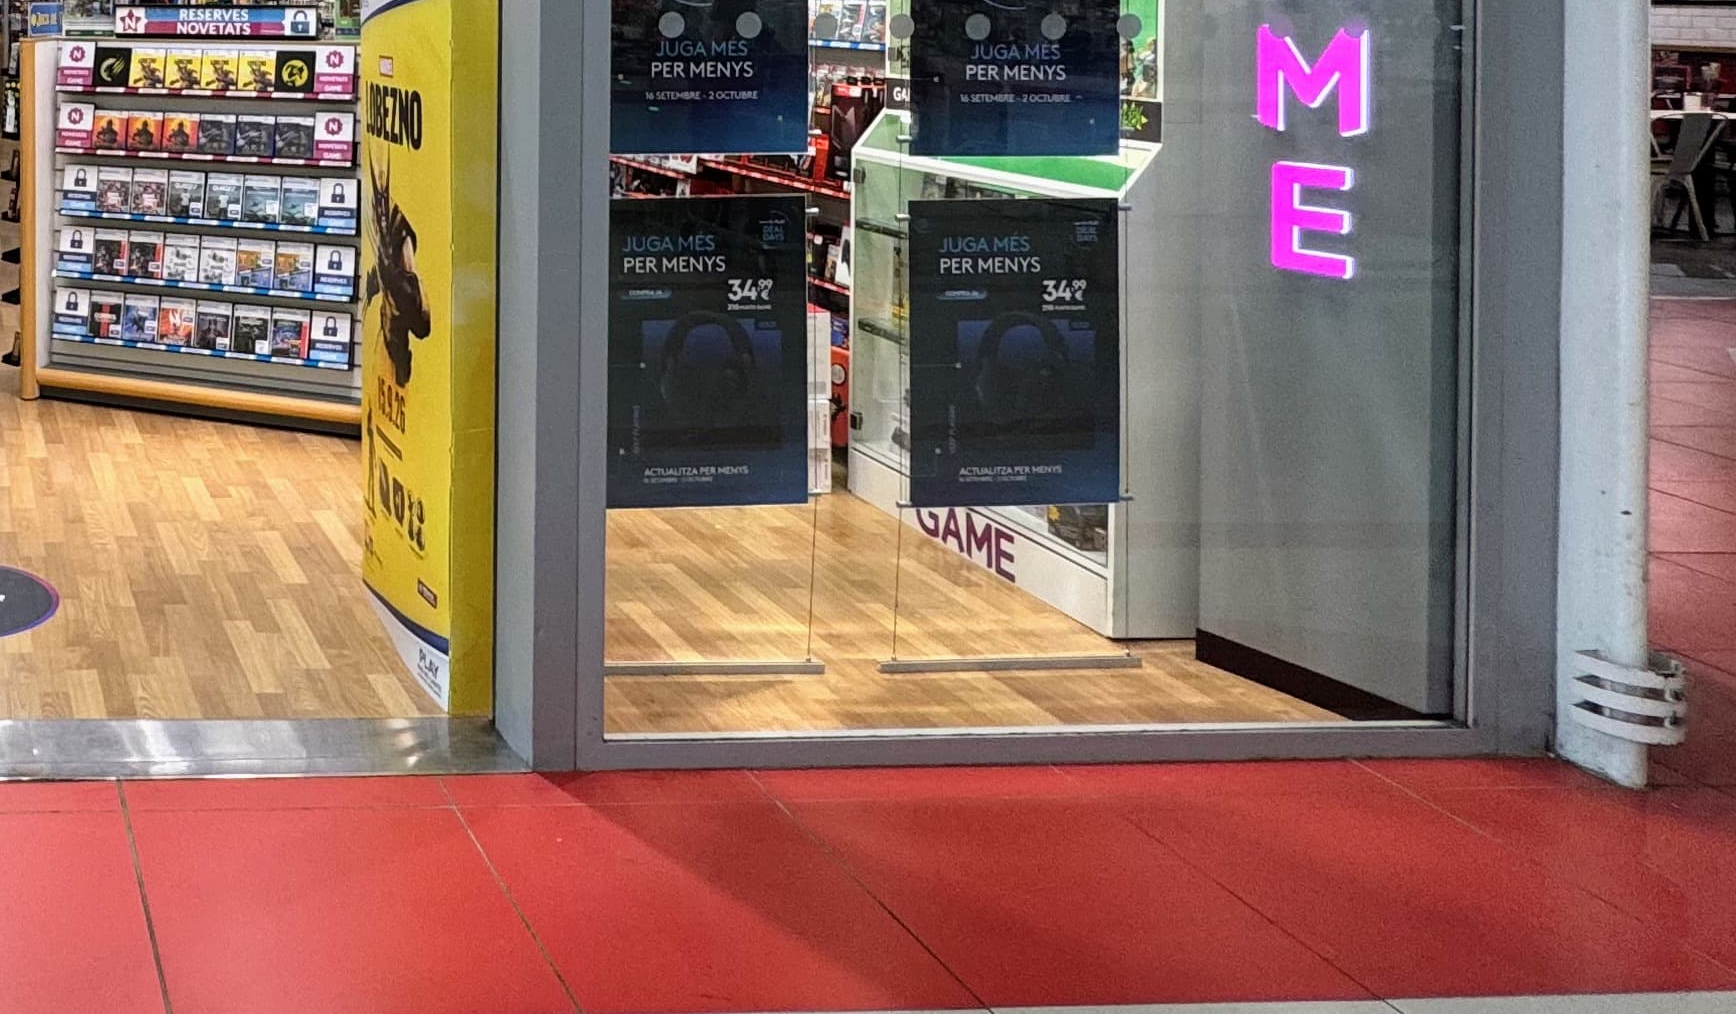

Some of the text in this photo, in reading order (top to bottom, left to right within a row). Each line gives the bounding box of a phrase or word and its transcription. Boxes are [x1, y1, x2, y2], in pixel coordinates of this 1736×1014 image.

[179, 8, 249, 22] RESERVES
[176, 22, 251, 35] NOVETATS
[656, 41, 705, 57] JUGA
[971, 45, 1020, 60] JUGA
[651, 62, 754, 78] PER MENYS
[966, 65, 1066, 81] PER MENYS
[645, 90, 655, 99] 16
[656, 91, 701, 100] SETEMBRE
[715, 90, 758, 99] OCTUBRE
[970, 94, 1014, 103] SETEMBRE
[1029, 94, 1071, 103] OCTUBRE
[365, 80, 423, 151] LOBEZNO
[623, 231, 715, 253] JUGA MÉS
[939, 232, 1030, 252] JUGA MÉS
[624, 256, 726, 273] PER MENYS
[940, 256, 1041, 274] PER MENYS
[644, 466, 749, 477] ACTUALITZA PER MENYS
[959, 465, 1062, 476] ACTUALITZA PER MENYS
[916, 507, 1016, 583] GAME
